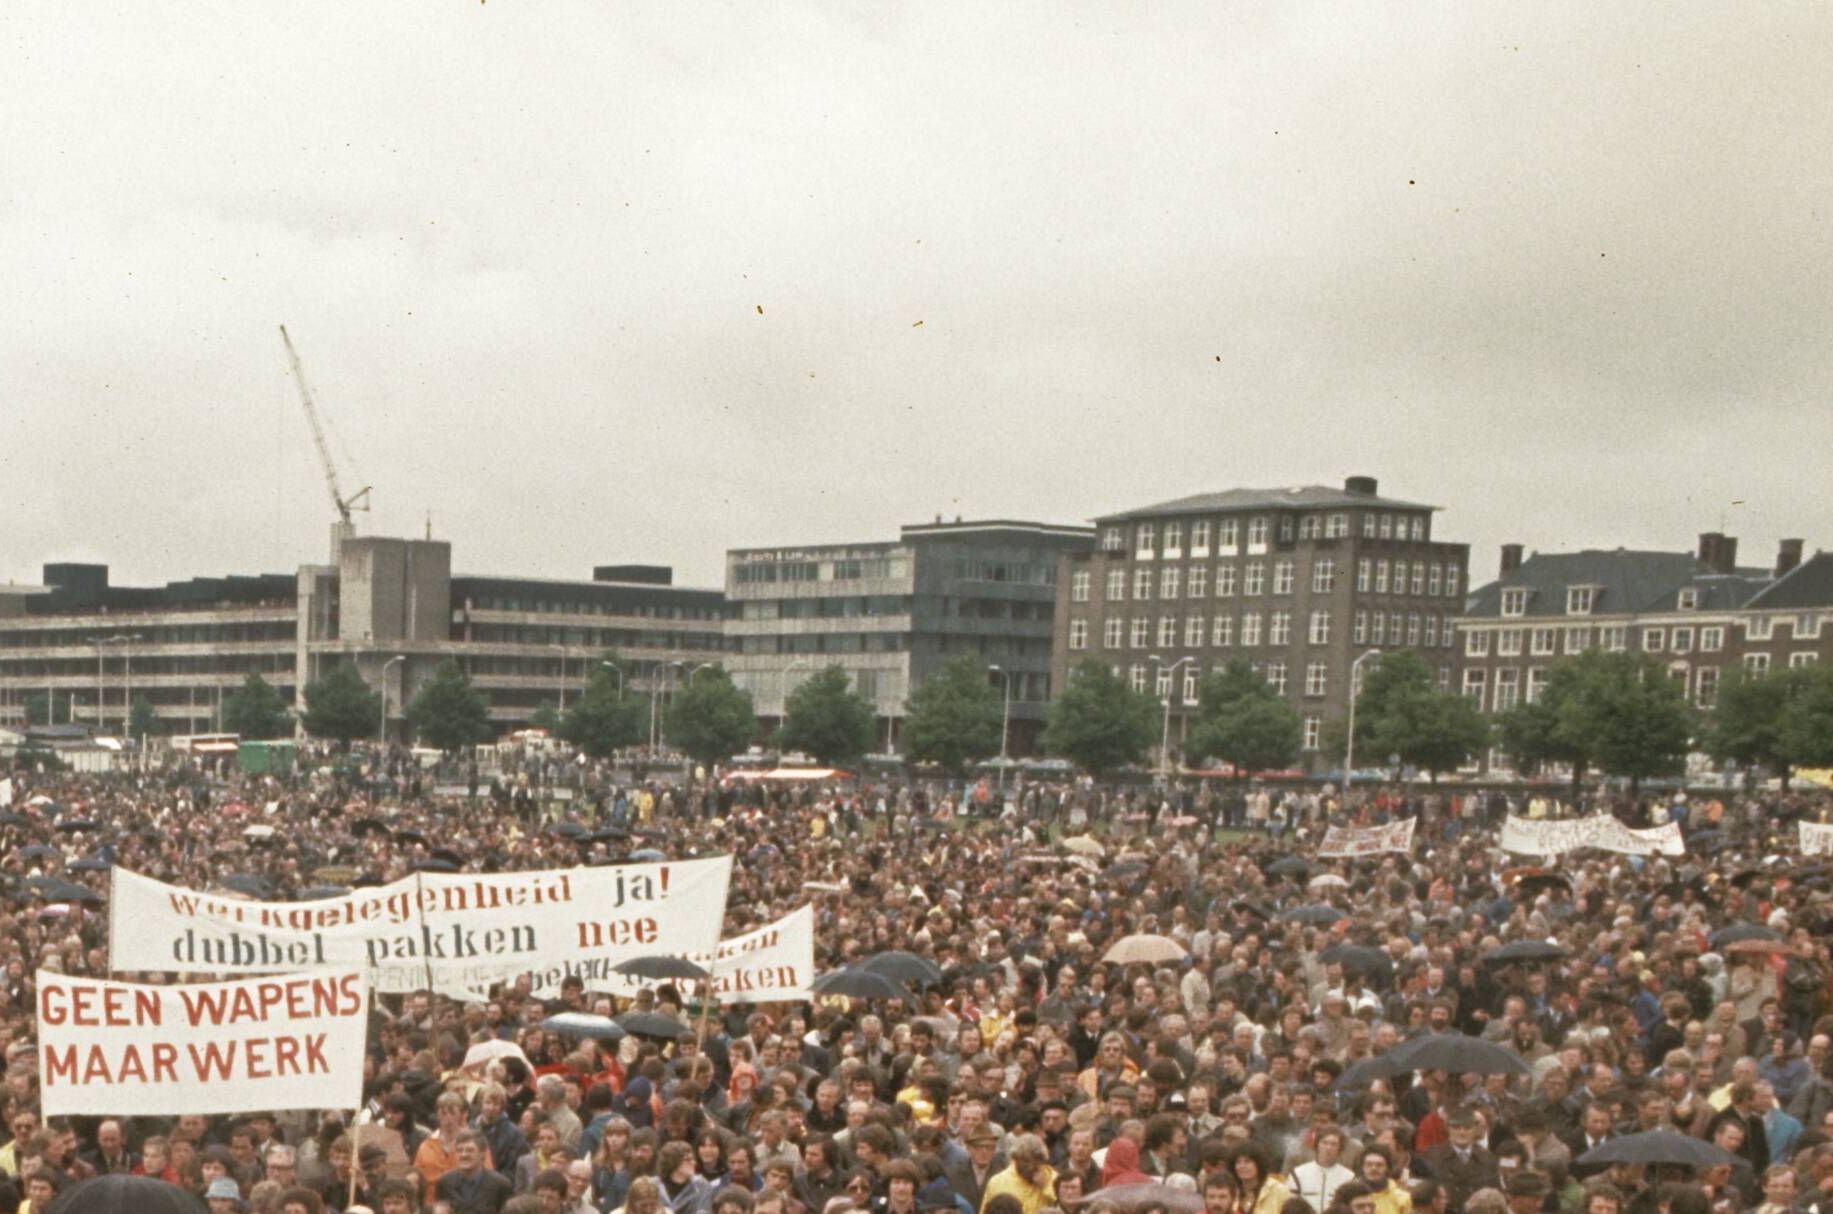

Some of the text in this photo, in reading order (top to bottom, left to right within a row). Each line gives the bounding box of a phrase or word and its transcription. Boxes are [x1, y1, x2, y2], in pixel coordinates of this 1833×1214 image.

[614, 867, 670, 908] ja!
[172, 928, 327, 967] dubbel
[365, 923, 538, 968] pakken
[577, 917, 658, 948] nee
[41, 972, 362, 1027] GEEN WAPENS
[44, 1032, 330, 1087] MAAR WERK
